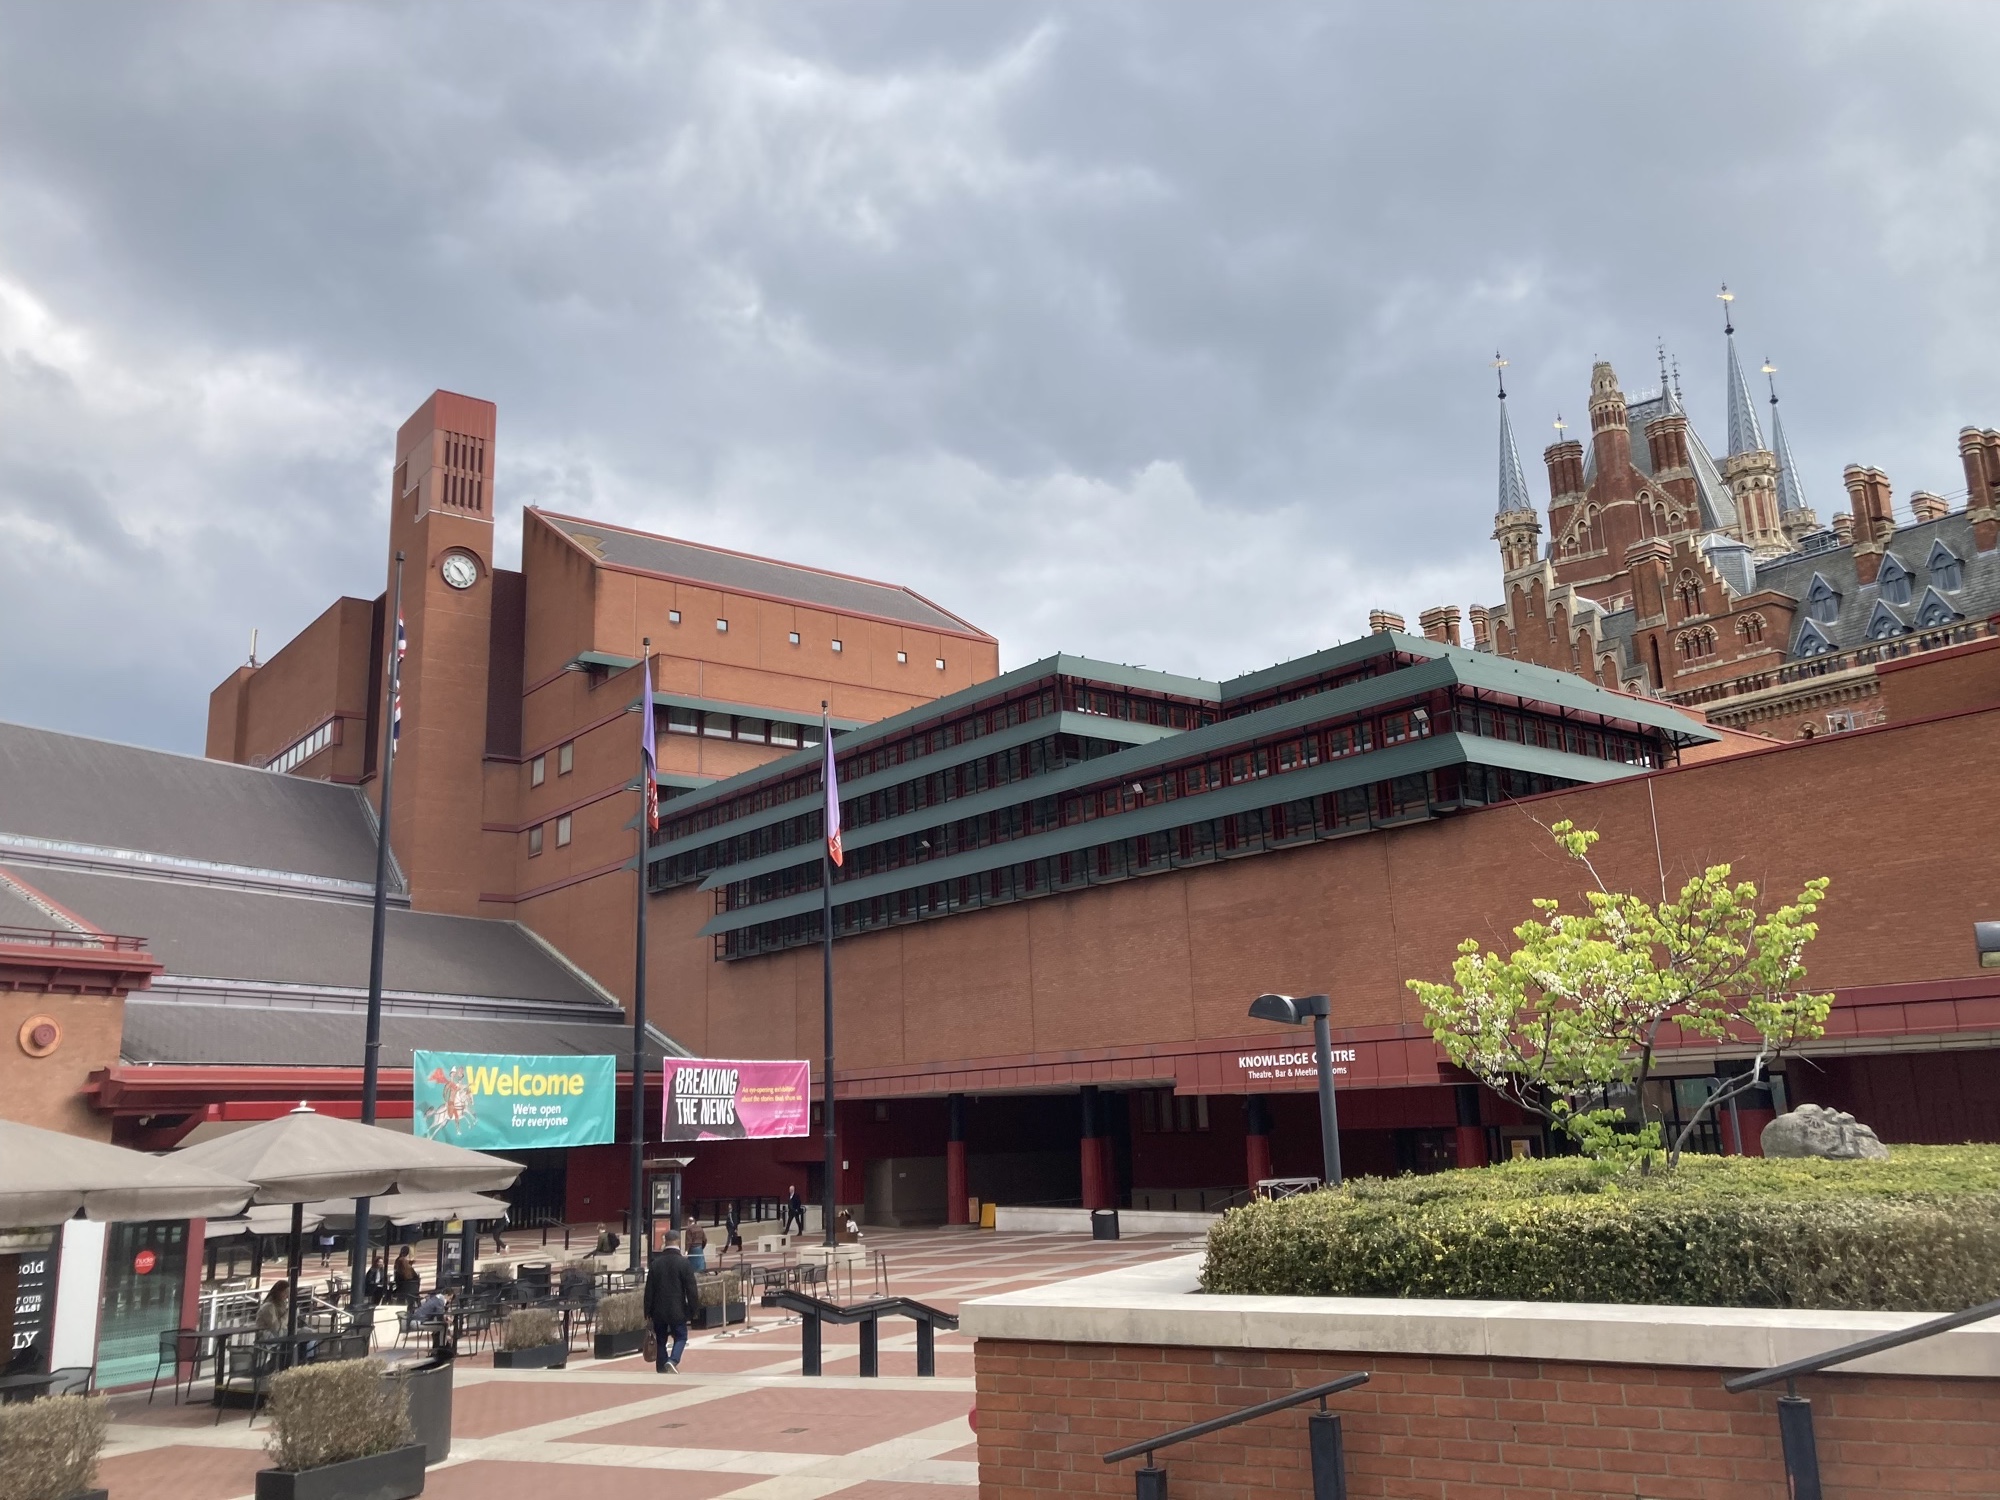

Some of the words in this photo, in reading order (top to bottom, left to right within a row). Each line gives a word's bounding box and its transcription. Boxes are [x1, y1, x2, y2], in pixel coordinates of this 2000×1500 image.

[1239, 1052, 1309, 1068] KNOWLEDGE
[1312, 1049, 1356, 1063] CTRE
[466, 1065, 585, 1097] Welcome
[676, 1067, 738, 1094] BREAKING
[1248, 1070, 1274, 1079] Theatre,
[1275, 1069, 1286, 1078] Bar
[1287, 1068, 1293, 1077] &
[1294, 1067, 1318, 1077] Meetin
[1332, 1066, 1347, 1074] oms
[513, 1103, 536, 1115] We're
[540, 1104, 562, 1117] open
[676, 1098, 699, 1125] THE
[701, 1098, 735, 1125] NEWS
[512, 1115, 525, 1127] for
[527, 1115, 568, 1130] everyone
[22, 1295, 42, 1304] OUR
